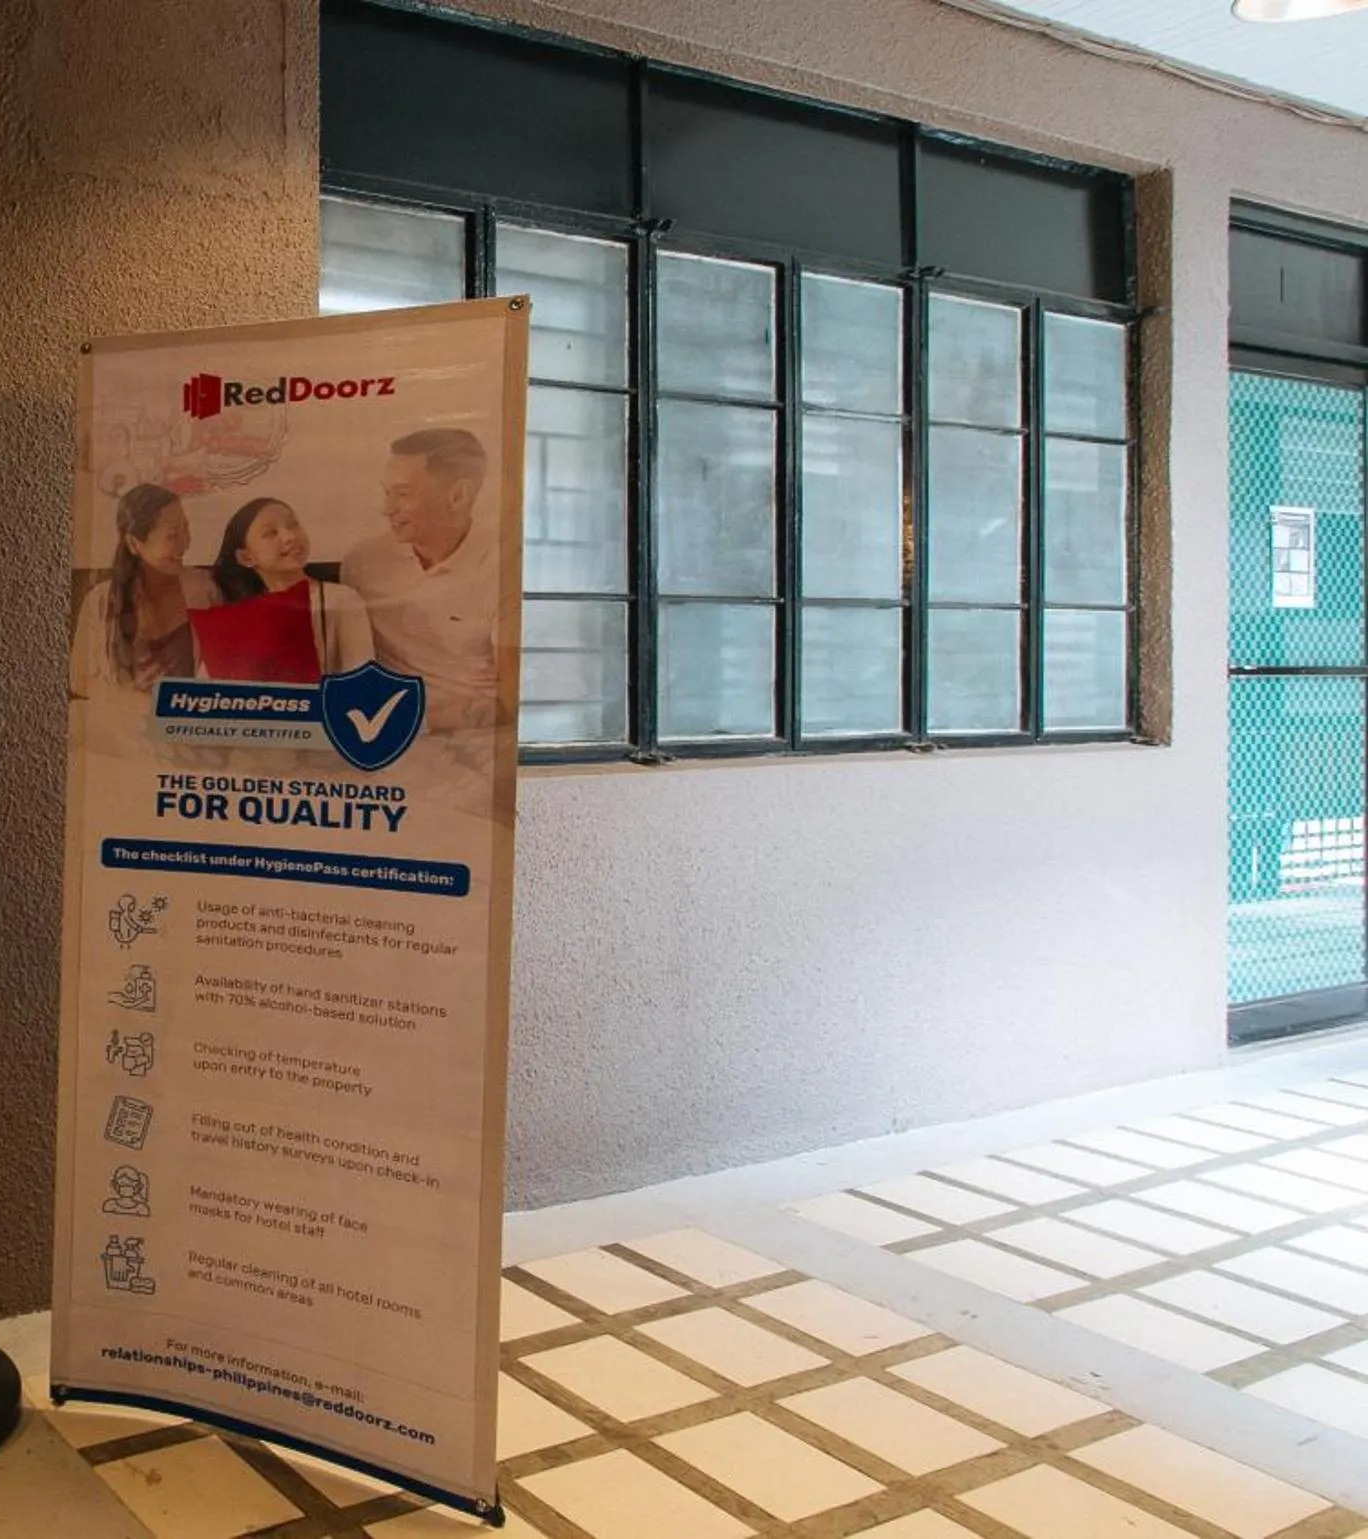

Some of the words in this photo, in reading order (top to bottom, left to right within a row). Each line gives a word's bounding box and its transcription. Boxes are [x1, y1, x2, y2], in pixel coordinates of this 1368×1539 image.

[224, 376, 395, 407] RedDoorz
[170, 692, 311, 713] HygienePass
[166, 725, 236, 738] OFFICIALLY
[242, 727, 312, 740] CERTIFIED
[157, 774, 196, 790] THE
[202, 776, 283, 795] GOLDEN
[289, 781, 405, 802] STANDARD
[156, 791, 229, 821] FOR
[238, 798, 408, 833] QUALITY
[113, 847, 139, 860] The
[141, 850, 207, 864] checklist
[210, 855, 251, 868] under
[255, 857, 349, 876] HygienePass
[351, 867, 455, 887] certification:
[196, 917, 256, 934] products
[260, 922, 285, 936] and
[288, 925, 379, 946] disinfectants
[383, 936, 403, 949] for
[406, 940, 459, 958] regular
[197, 900, 238, 916] Usage
[242, 904, 256, 916] of
[259, 907, 352, 926] anti-bacterial
[354, 916, 416, 937] cleaning
[195, 933, 263, 949] sanitation
[266, 940, 343, 959] procedures
[194, 991, 224, 1004] with
[228, 993, 256, 1007] 70%
[259, 998, 355, 1022] alcohol-based
[359, 1012, 416, 1031] solution
[195, 974, 267, 993] Availability
[270, 982, 284, 994] of
[287, 985, 322, 1000] hand
[324, 990, 383, 1008] sanitizer
[388, 999, 448, 1019] stations
[193, 1042, 256, 1062] Checking
[259, 1050, 274, 1062] of
[276, 1053, 361, 1078] temperature
[193, 1060, 227, 1075] upon
[230, 1063, 267, 1080] entry
[269, 1067, 283, 1081] to
[286, 1070, 309, 1084] the
[312, 1075, 372, 1098] property
[191, 1112, 231, 1132] Filling
[233, 1121, 256, 1134] out
[260, 1123, 275, 1136] of
[277, 1127, 320, 1145] health
[324, 1135, 391, 1160] condition
[393, 1151, 420, 1166] and
[191, 1130, 229, 1147] travel
[232, 1135, 279, 1155] history
[282, 1145, 334, 1165] surveys
[338, 1158, 374, 1175] upon
[376, 1165, 441, 1189] check-in
[189, 1203, 231, 1220] masks
[234, 1211, 253, 1225] for
[255, 1214, 291, 1231] hotel
[294, 1222, 325, 1239] staff
[190, 1184, 260, 1210] Mandatory
[263, 1200, 317, 1223] wearing
[320, 1211, 335, 1224] of
[338, 1215, 368, 1233] face
[188, 1250, 238, 1272] Regular
[241, 1262, 298, 1288] cleaning
[301, 1277, 316, 1290] of
[318, 1281, 334, 1296] all
[337, 1286, 373, 1306] hotel
[377, 1297, 422, 1320] rooms
[188, 1268, 213, 1283] and
[215, 1274, 274, 1296] common
[277, 1289, 314, 1307] areas
[166, 1338, 188, 1353] For
[191, 1345, 225, 1363] more
[227, 1353, 312, 1387] information,
[314, 1379, 365, 1403] e-mail:
[101, 1346, 436, 1446] relationships-philippines@reddoorz.com
